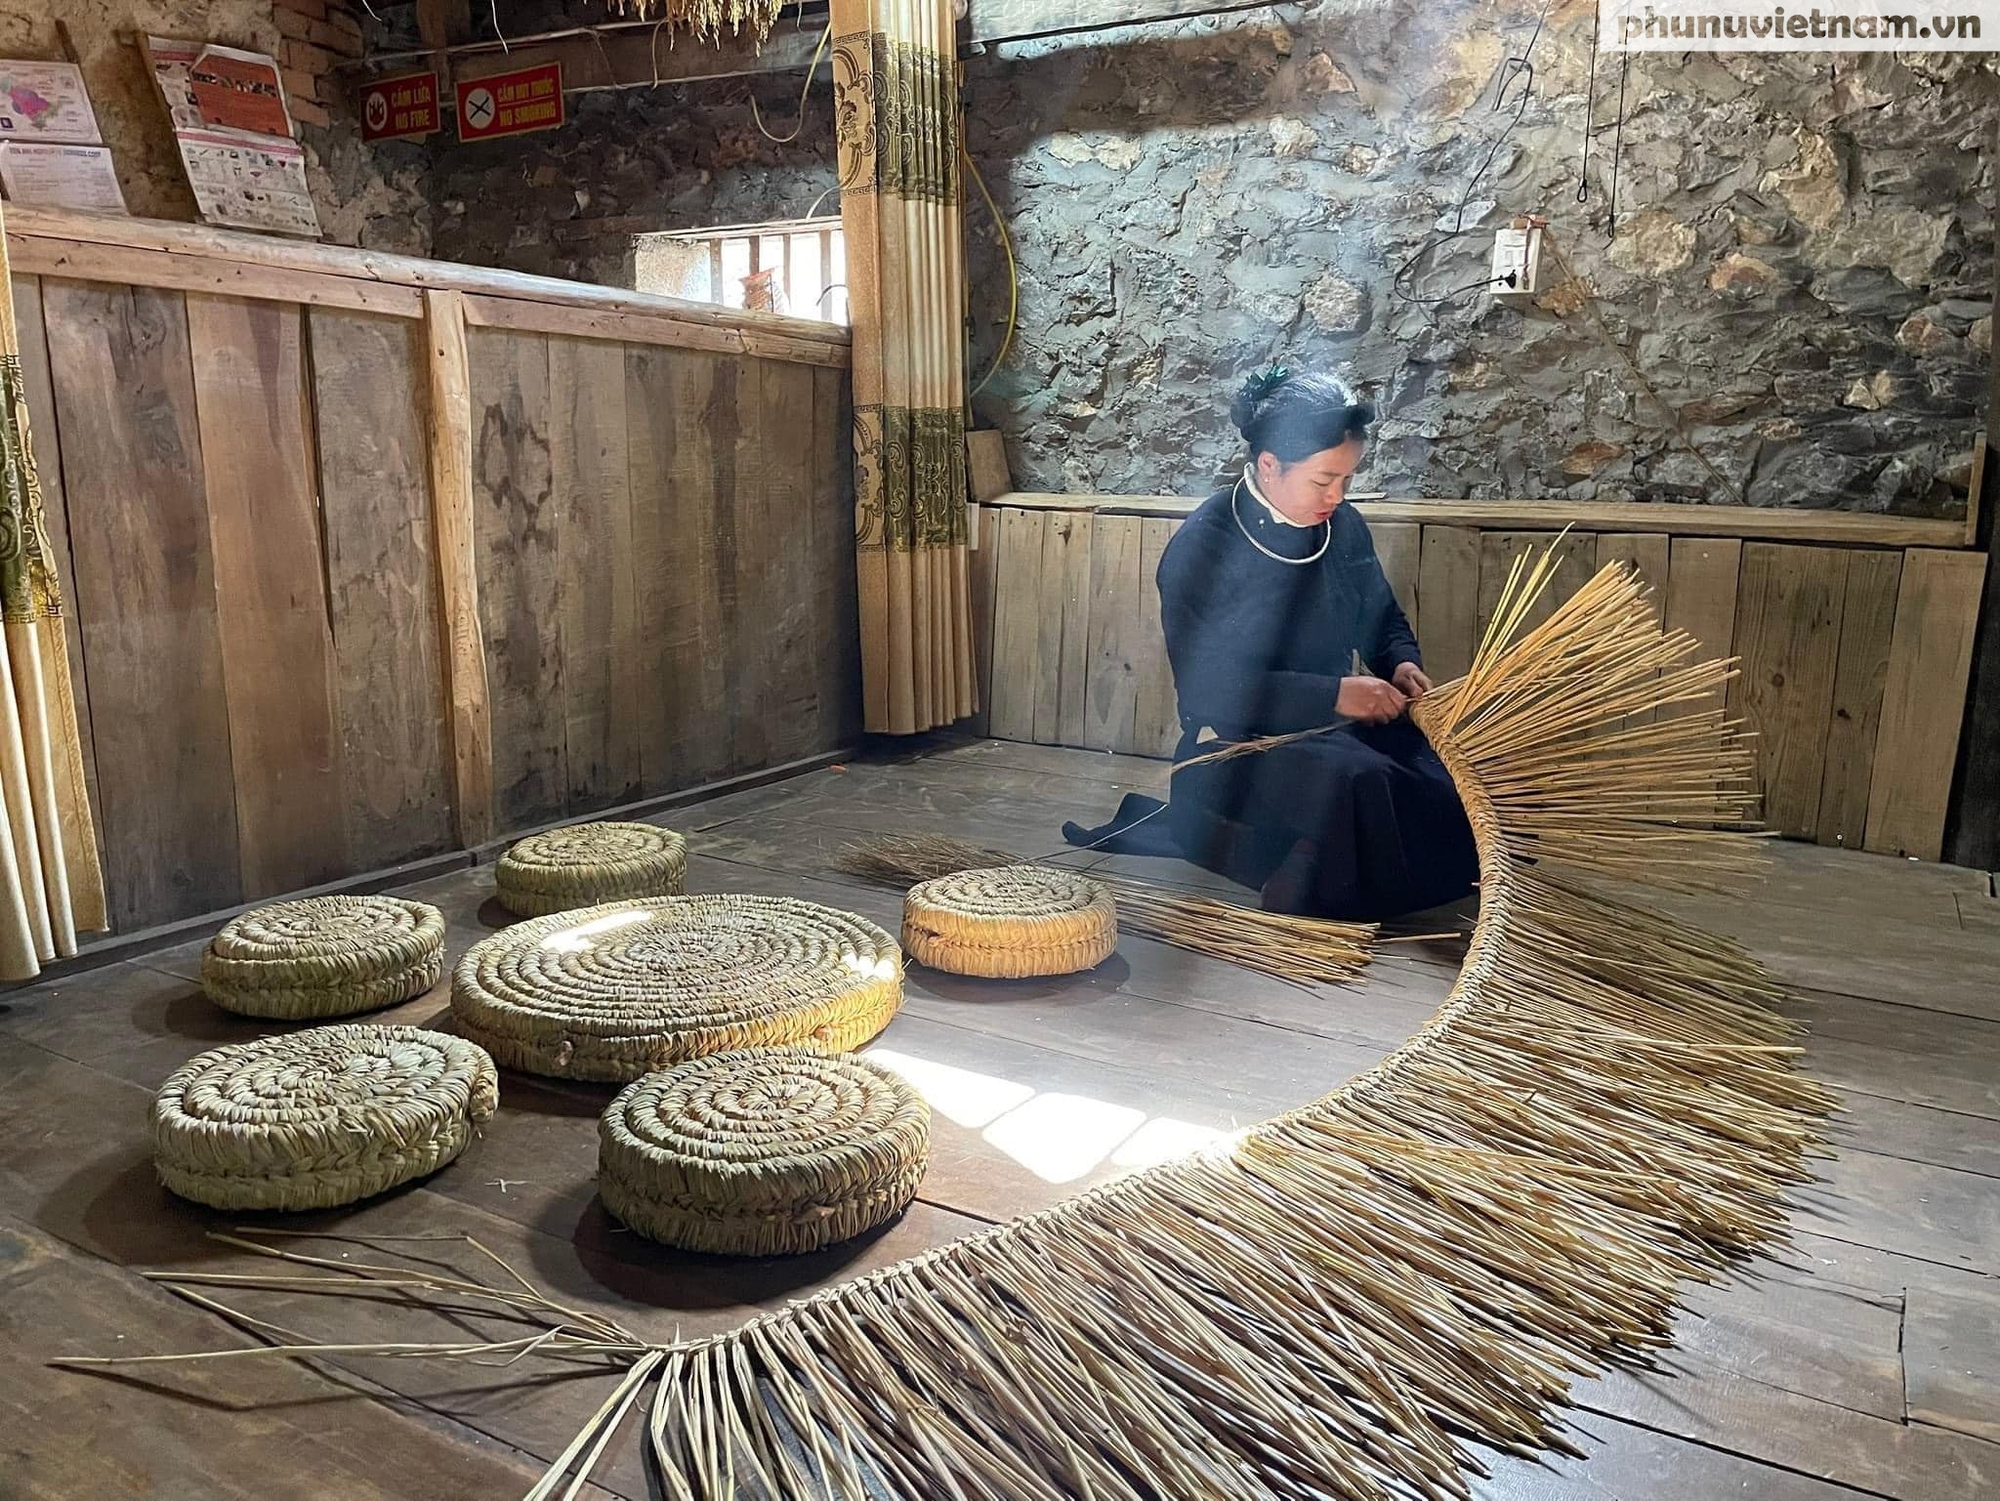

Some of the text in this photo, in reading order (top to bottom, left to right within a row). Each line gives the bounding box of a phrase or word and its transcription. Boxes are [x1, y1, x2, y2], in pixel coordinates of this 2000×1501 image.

[395, 109, 430, 130] NO FIRE
[500, 101, 556, 127] NO SMOKING
